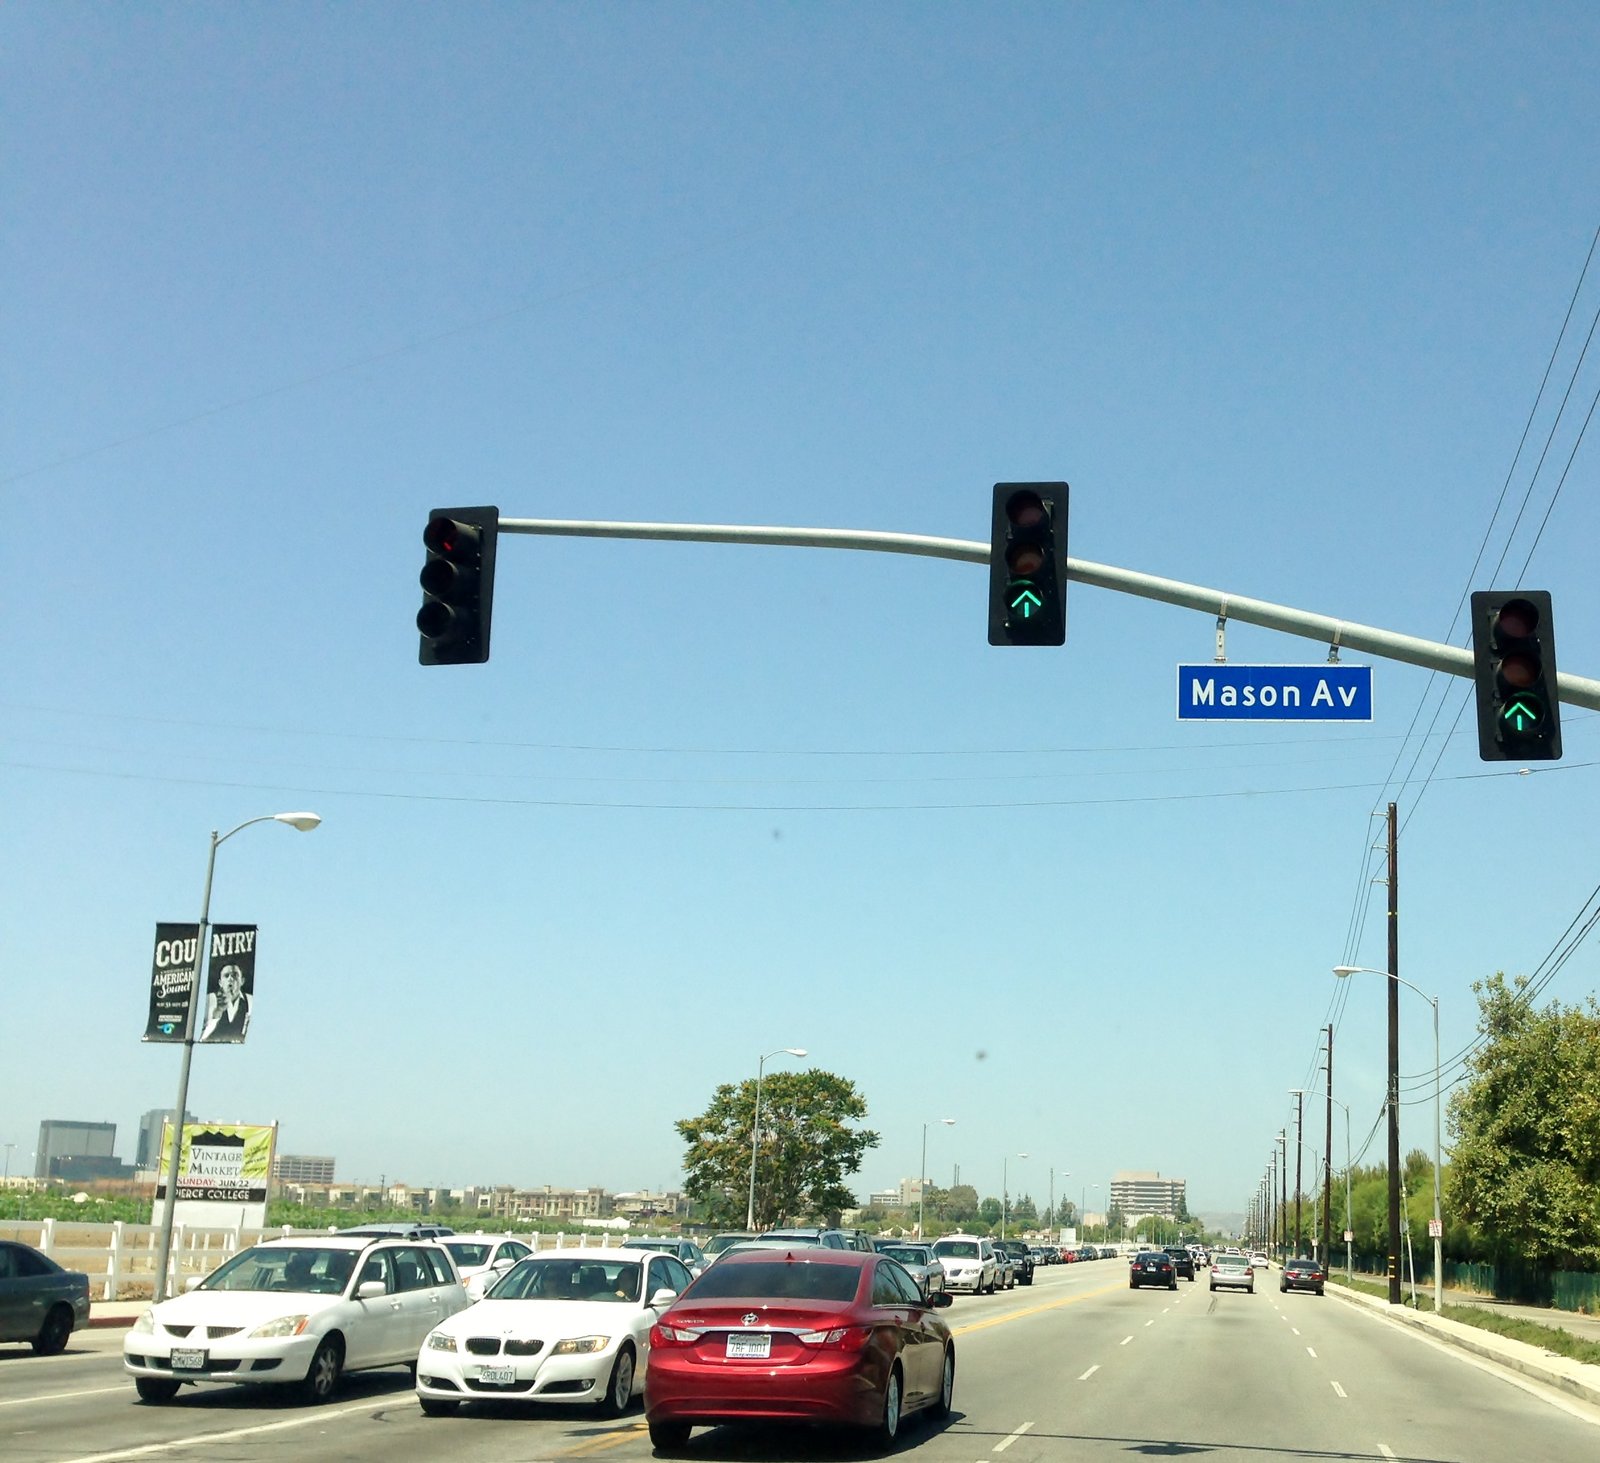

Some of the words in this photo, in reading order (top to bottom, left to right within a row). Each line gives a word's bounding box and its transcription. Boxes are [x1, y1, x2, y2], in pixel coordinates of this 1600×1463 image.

[1192, 678, 1300, 707] Mason
[1310, 679, 1358, 707] Av
[211, 931, 255, 957] NTRY
[153, 970, 195, 986] AMERICAN
[156, 982, 191, 998] Sound
[218, 1179, 237, 1188] JUN
[239, 1180, 249, 1188] 22
[207, 1188, 250, 1200] COLLEGE
